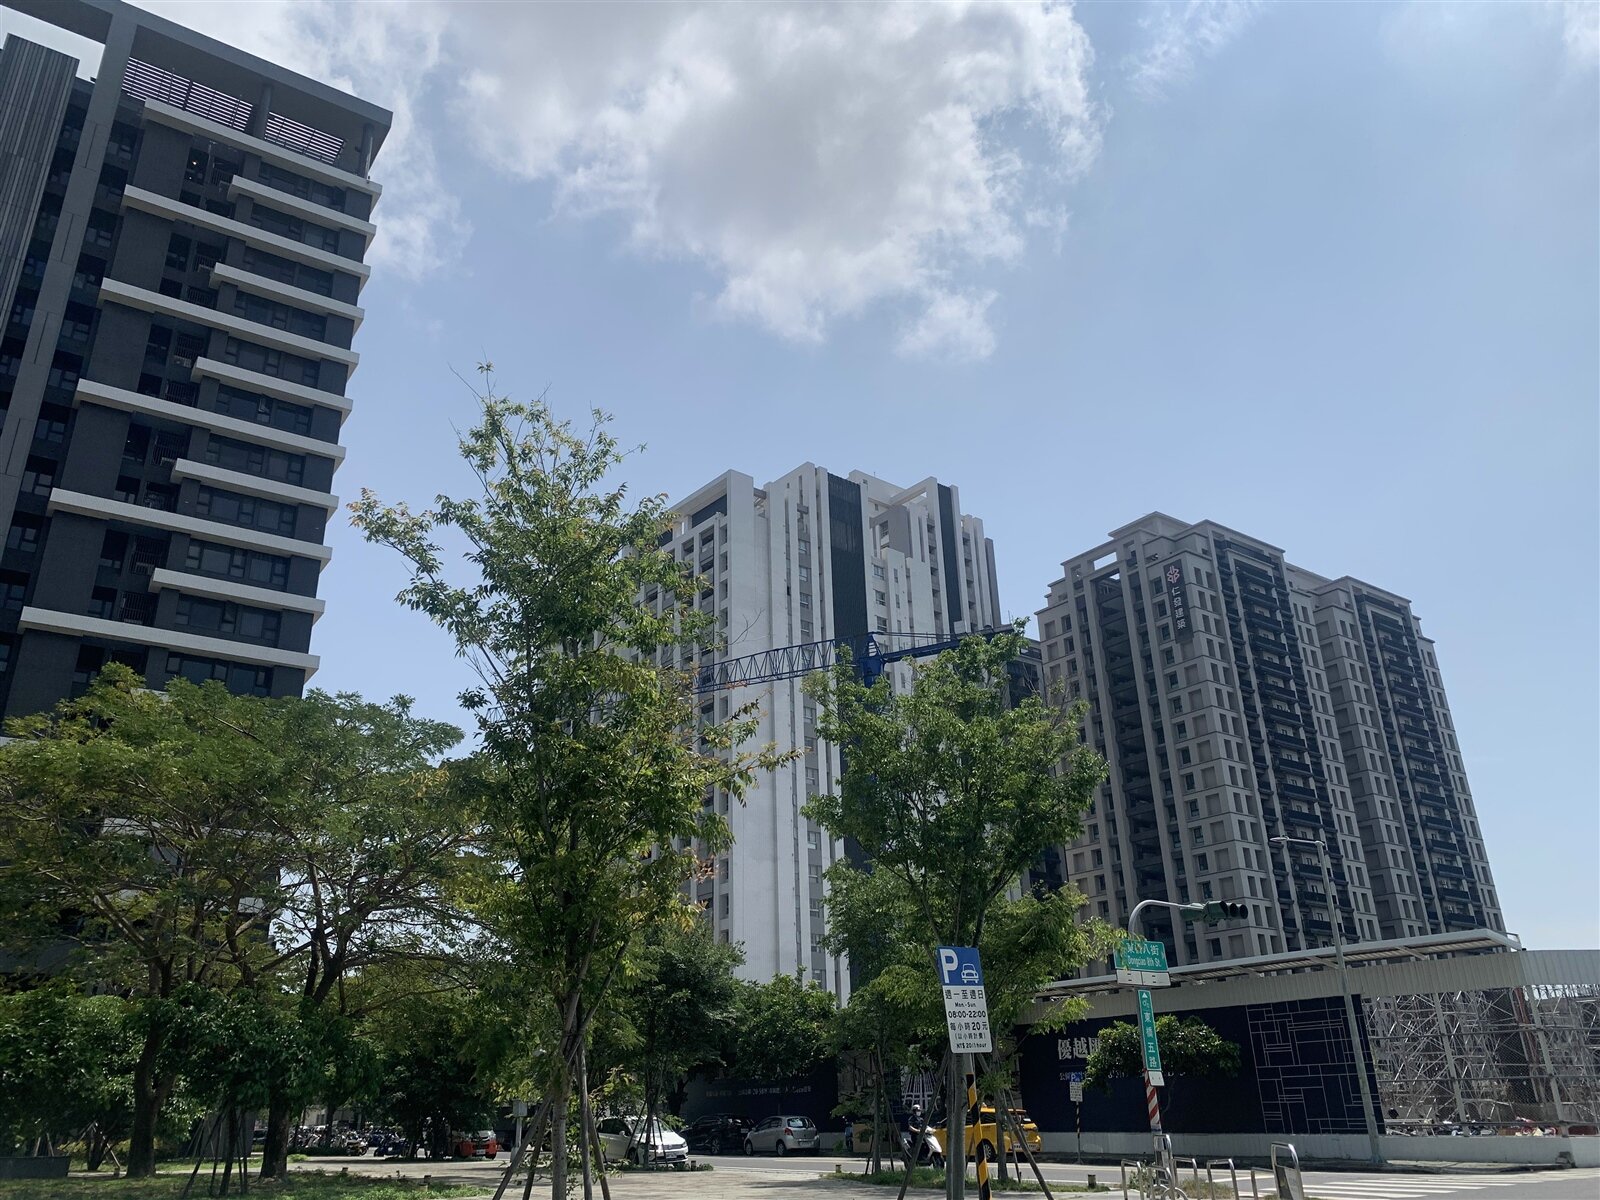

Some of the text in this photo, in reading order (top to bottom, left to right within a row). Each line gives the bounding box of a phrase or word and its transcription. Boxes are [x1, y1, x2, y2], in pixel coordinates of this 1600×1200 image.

[940, 949, 958, 983] P
[945, 989, 984, 999] 週一至週日
[948, 1010, 986, 1018] 08:00-22:00
[1144, 1012, 1158, 1068] 東橋五路
